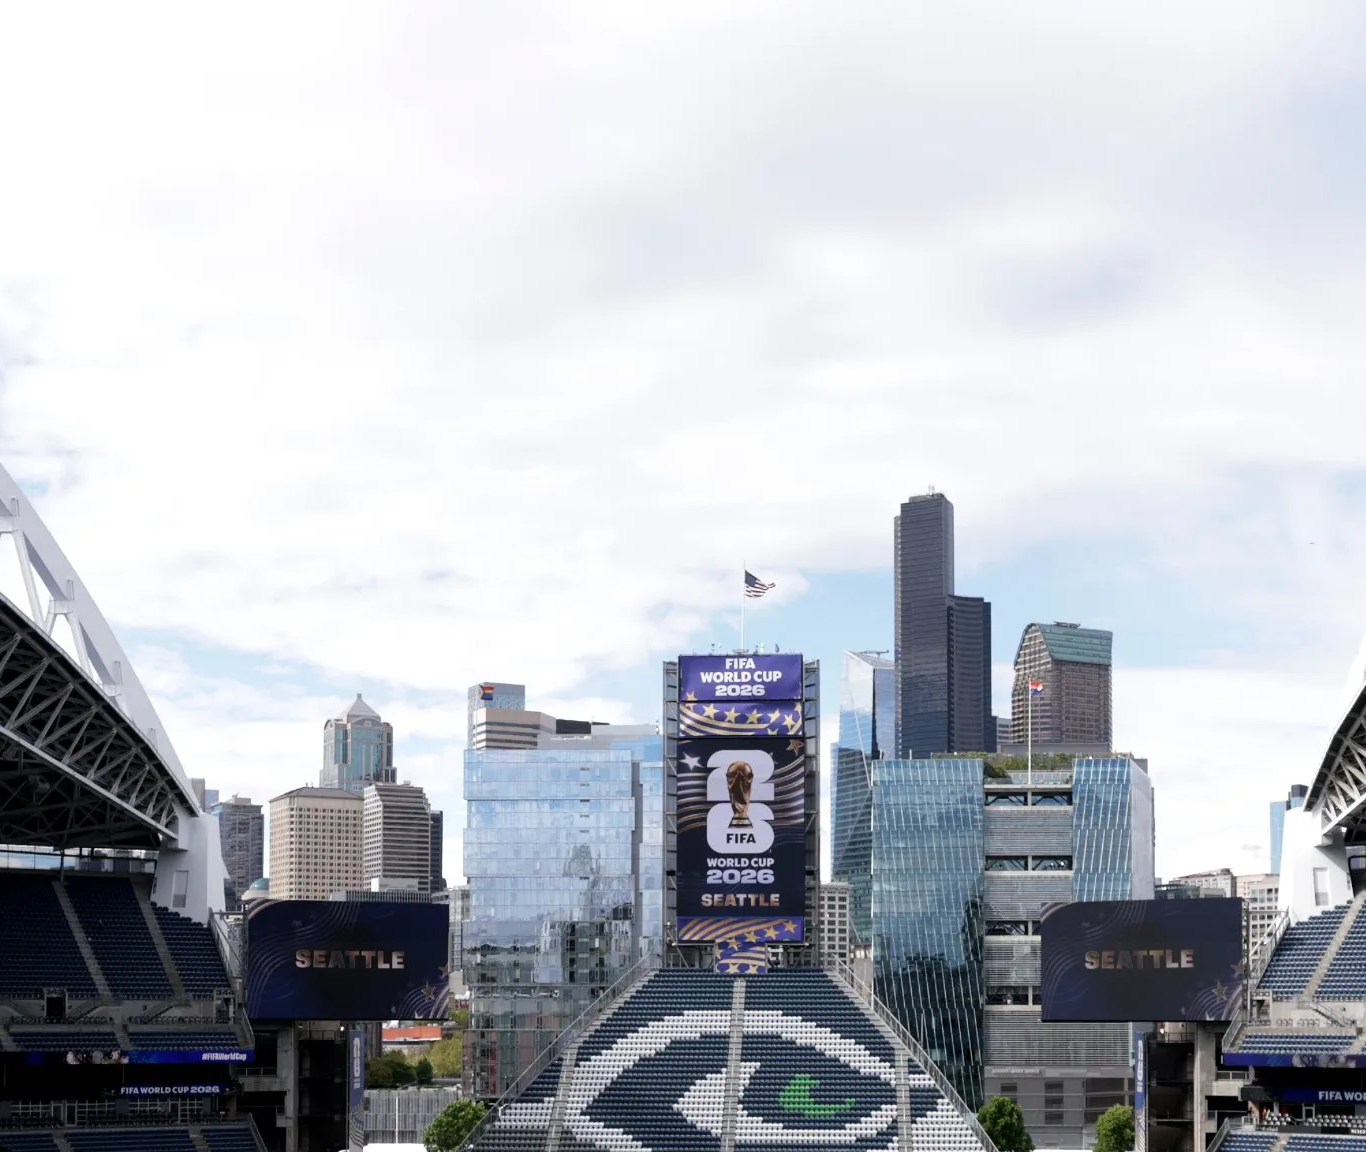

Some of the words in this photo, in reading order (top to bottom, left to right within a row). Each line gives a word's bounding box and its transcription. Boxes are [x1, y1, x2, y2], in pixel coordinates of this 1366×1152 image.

[725, 658, 756, 670] FIFA
[700, 671, 743, 683] WORLD
[744, 671, 782, 683] CUP
[714, 684, 766, 697] 2026
[726, 833, 756, 844] FIFA
[706, 857, 750, 868] WORLD
[751, 857, 775, 868] CUP
[706, 869, 775, 884] 2026
[701, 893, 780, 907] SEATTLE
[295, 949, 405, 969] SEATTLE
[1085, 949, 1195, 969] SEATTLE
[201, 1051, 247, 1063] #FIFAWorldCup
[120, 1085, 140, 1096] FIFA
[140, 1085, 171, 1096] WORLD
[171, 1085, 189, 1095] CUP
[190, 1084, 220, 1095] 2026
[1318, 1090, 1343, 1101] FIFA
